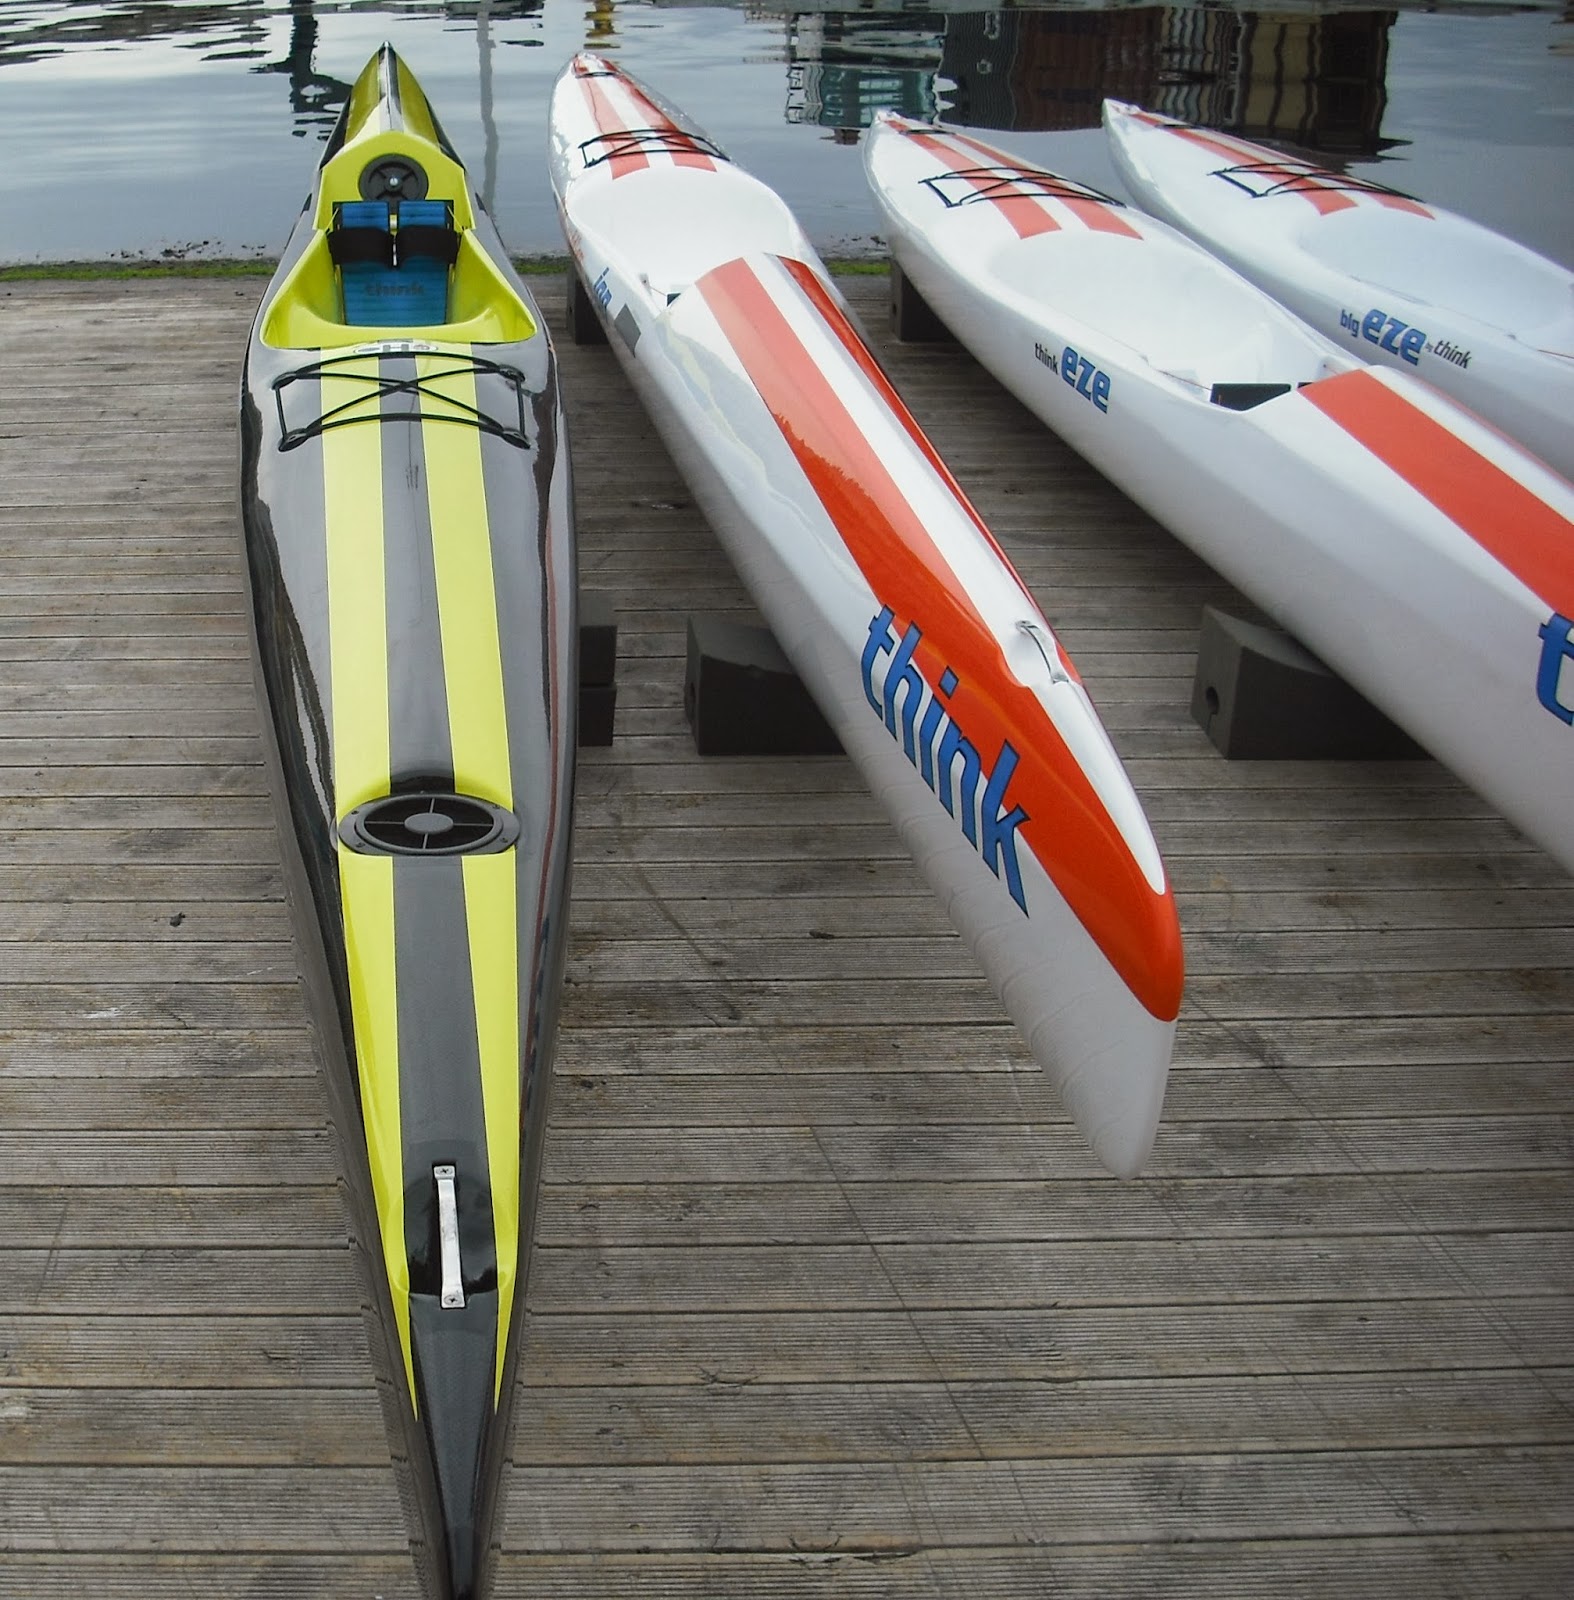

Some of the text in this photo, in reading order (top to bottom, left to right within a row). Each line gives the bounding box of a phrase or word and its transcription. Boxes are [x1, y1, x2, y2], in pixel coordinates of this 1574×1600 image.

[1340, 309, 1360, 338] big
[1362, 308, 1427, 366] eze
[1434, 340, 1472, 369] think
[1035, 342, 1111, 414] think eze
[861, 604, 1031, 918] think
